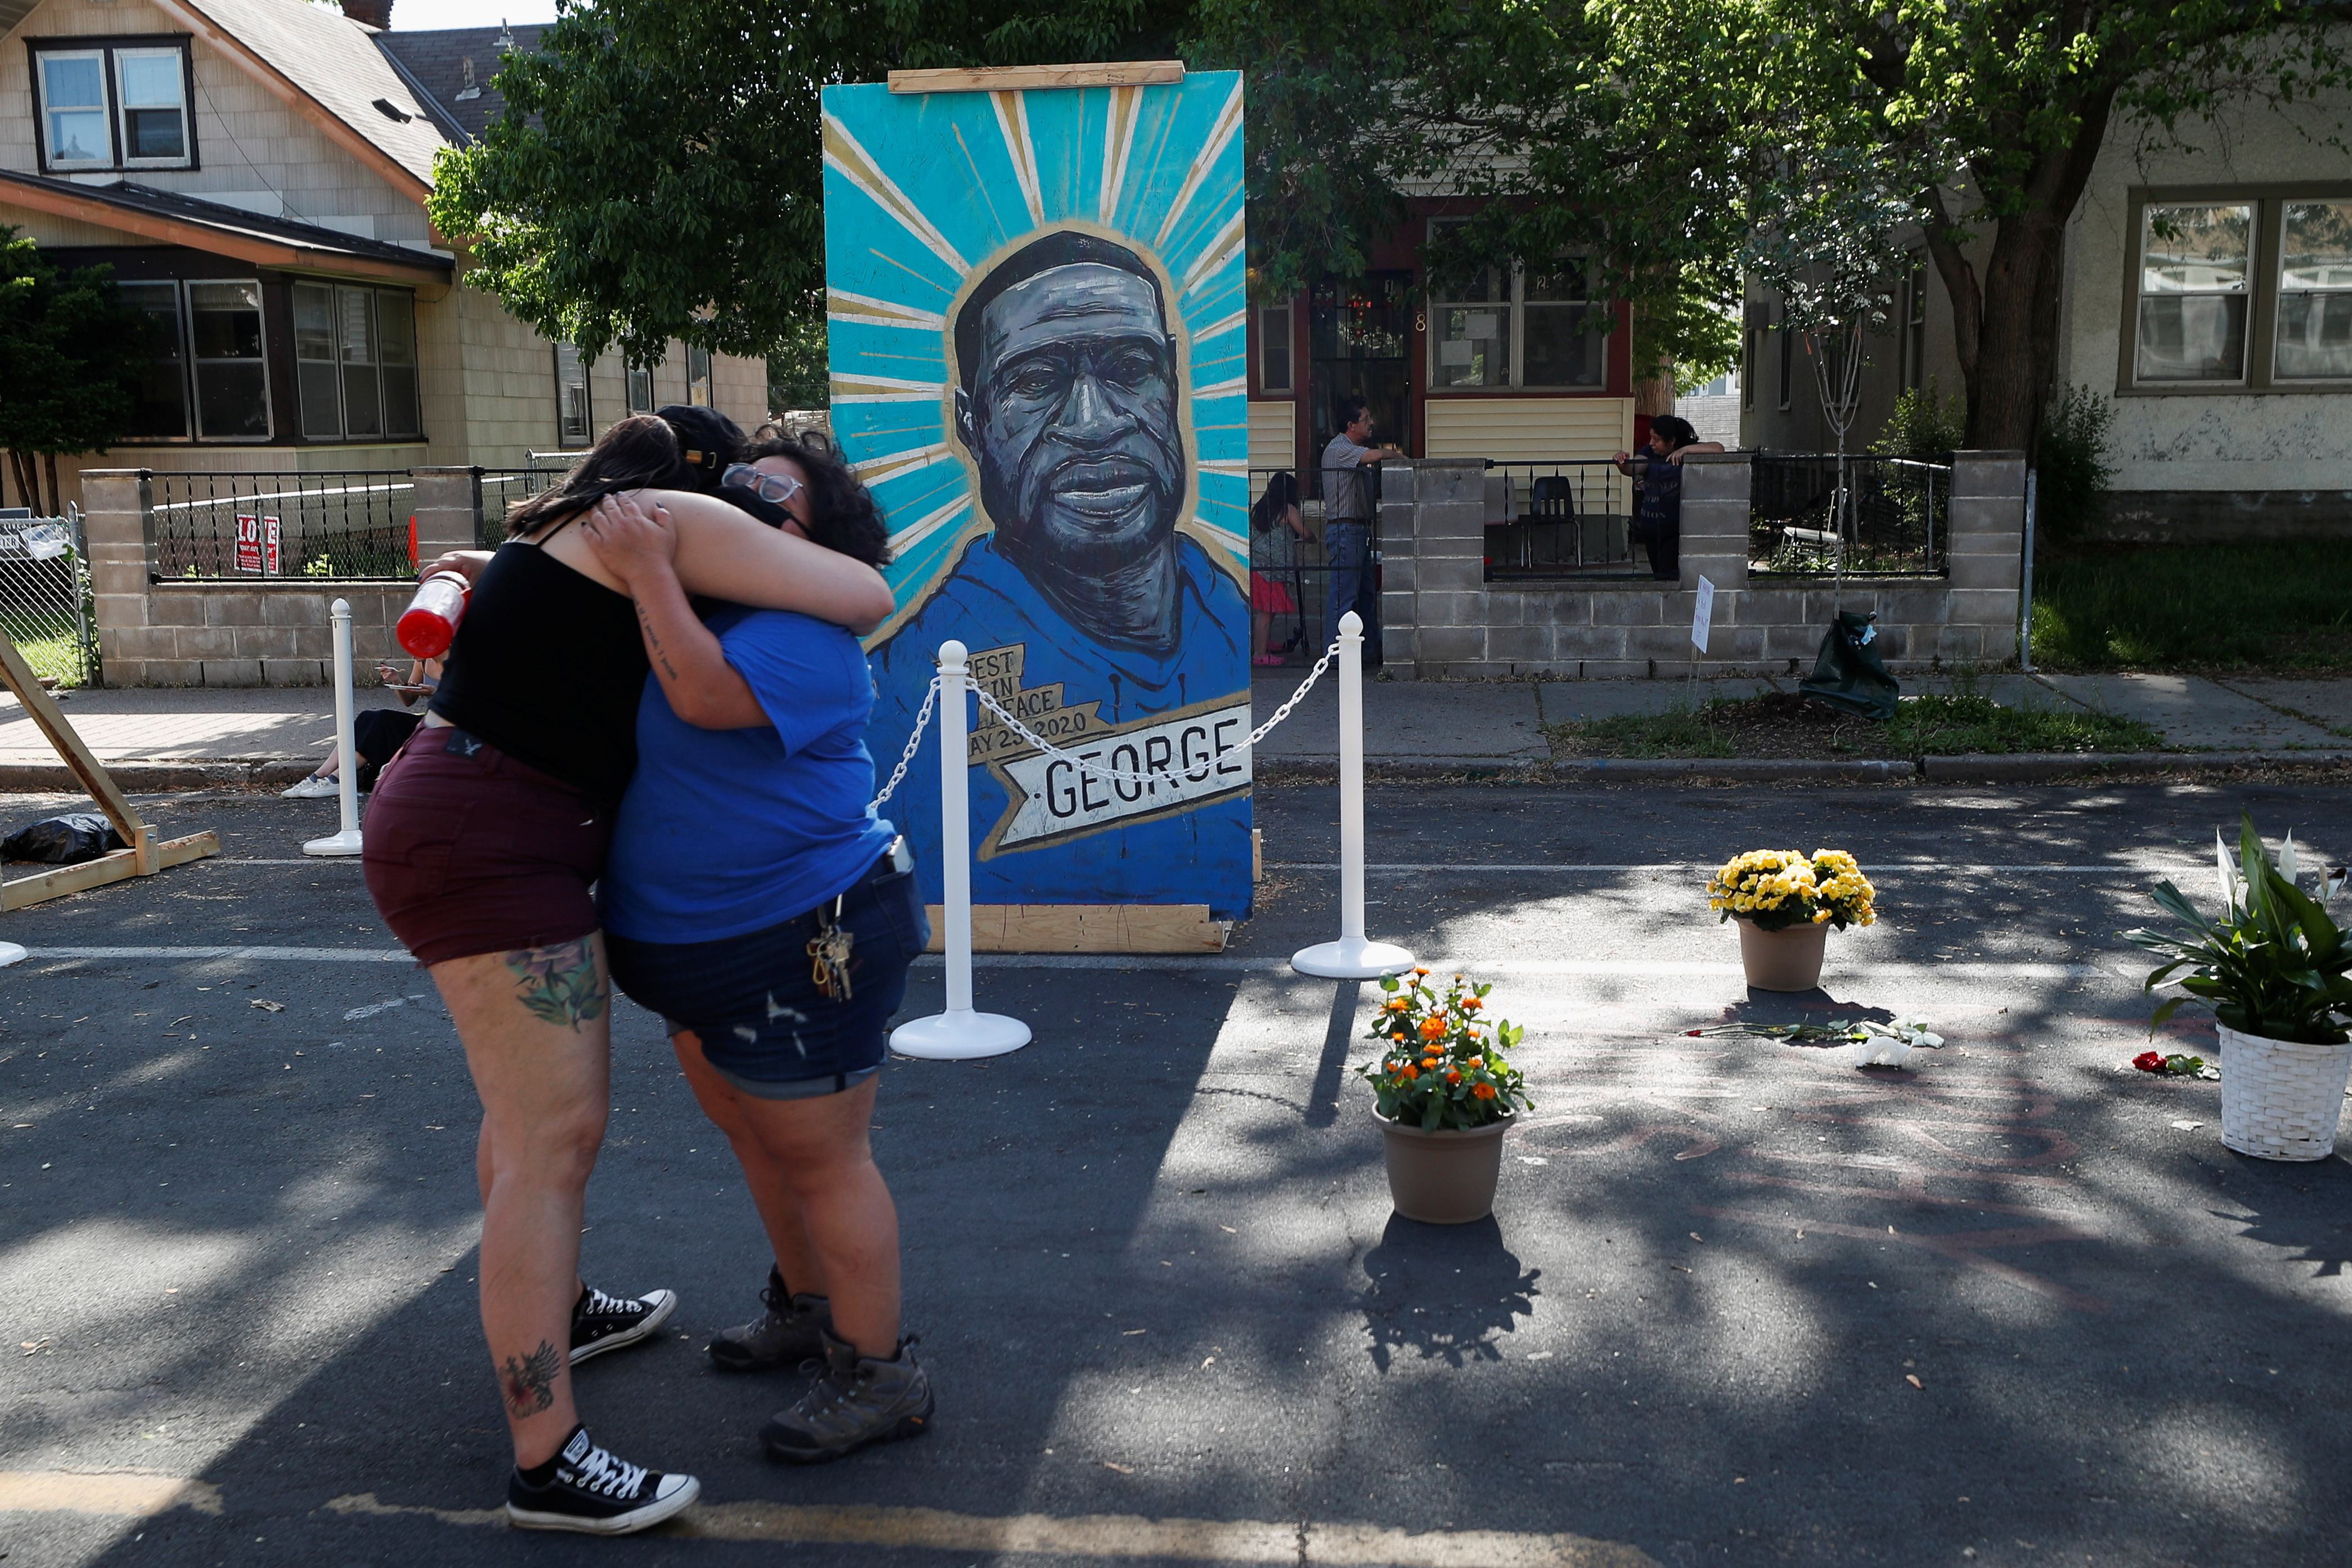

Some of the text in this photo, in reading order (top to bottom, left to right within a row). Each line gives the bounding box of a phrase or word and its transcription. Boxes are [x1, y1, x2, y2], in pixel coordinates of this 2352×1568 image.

[1537, 277, 1545, 290] 2
[1416, 314, 1425, 331] 8
[991, 677, 1012, 698] IN
[989, 690, 1054, 726] PEACE
[967, 733, 993, 757] AY
[1033, 712, 1086, 739] 2020
[1045, 718, 1242, 818] GEORGE
